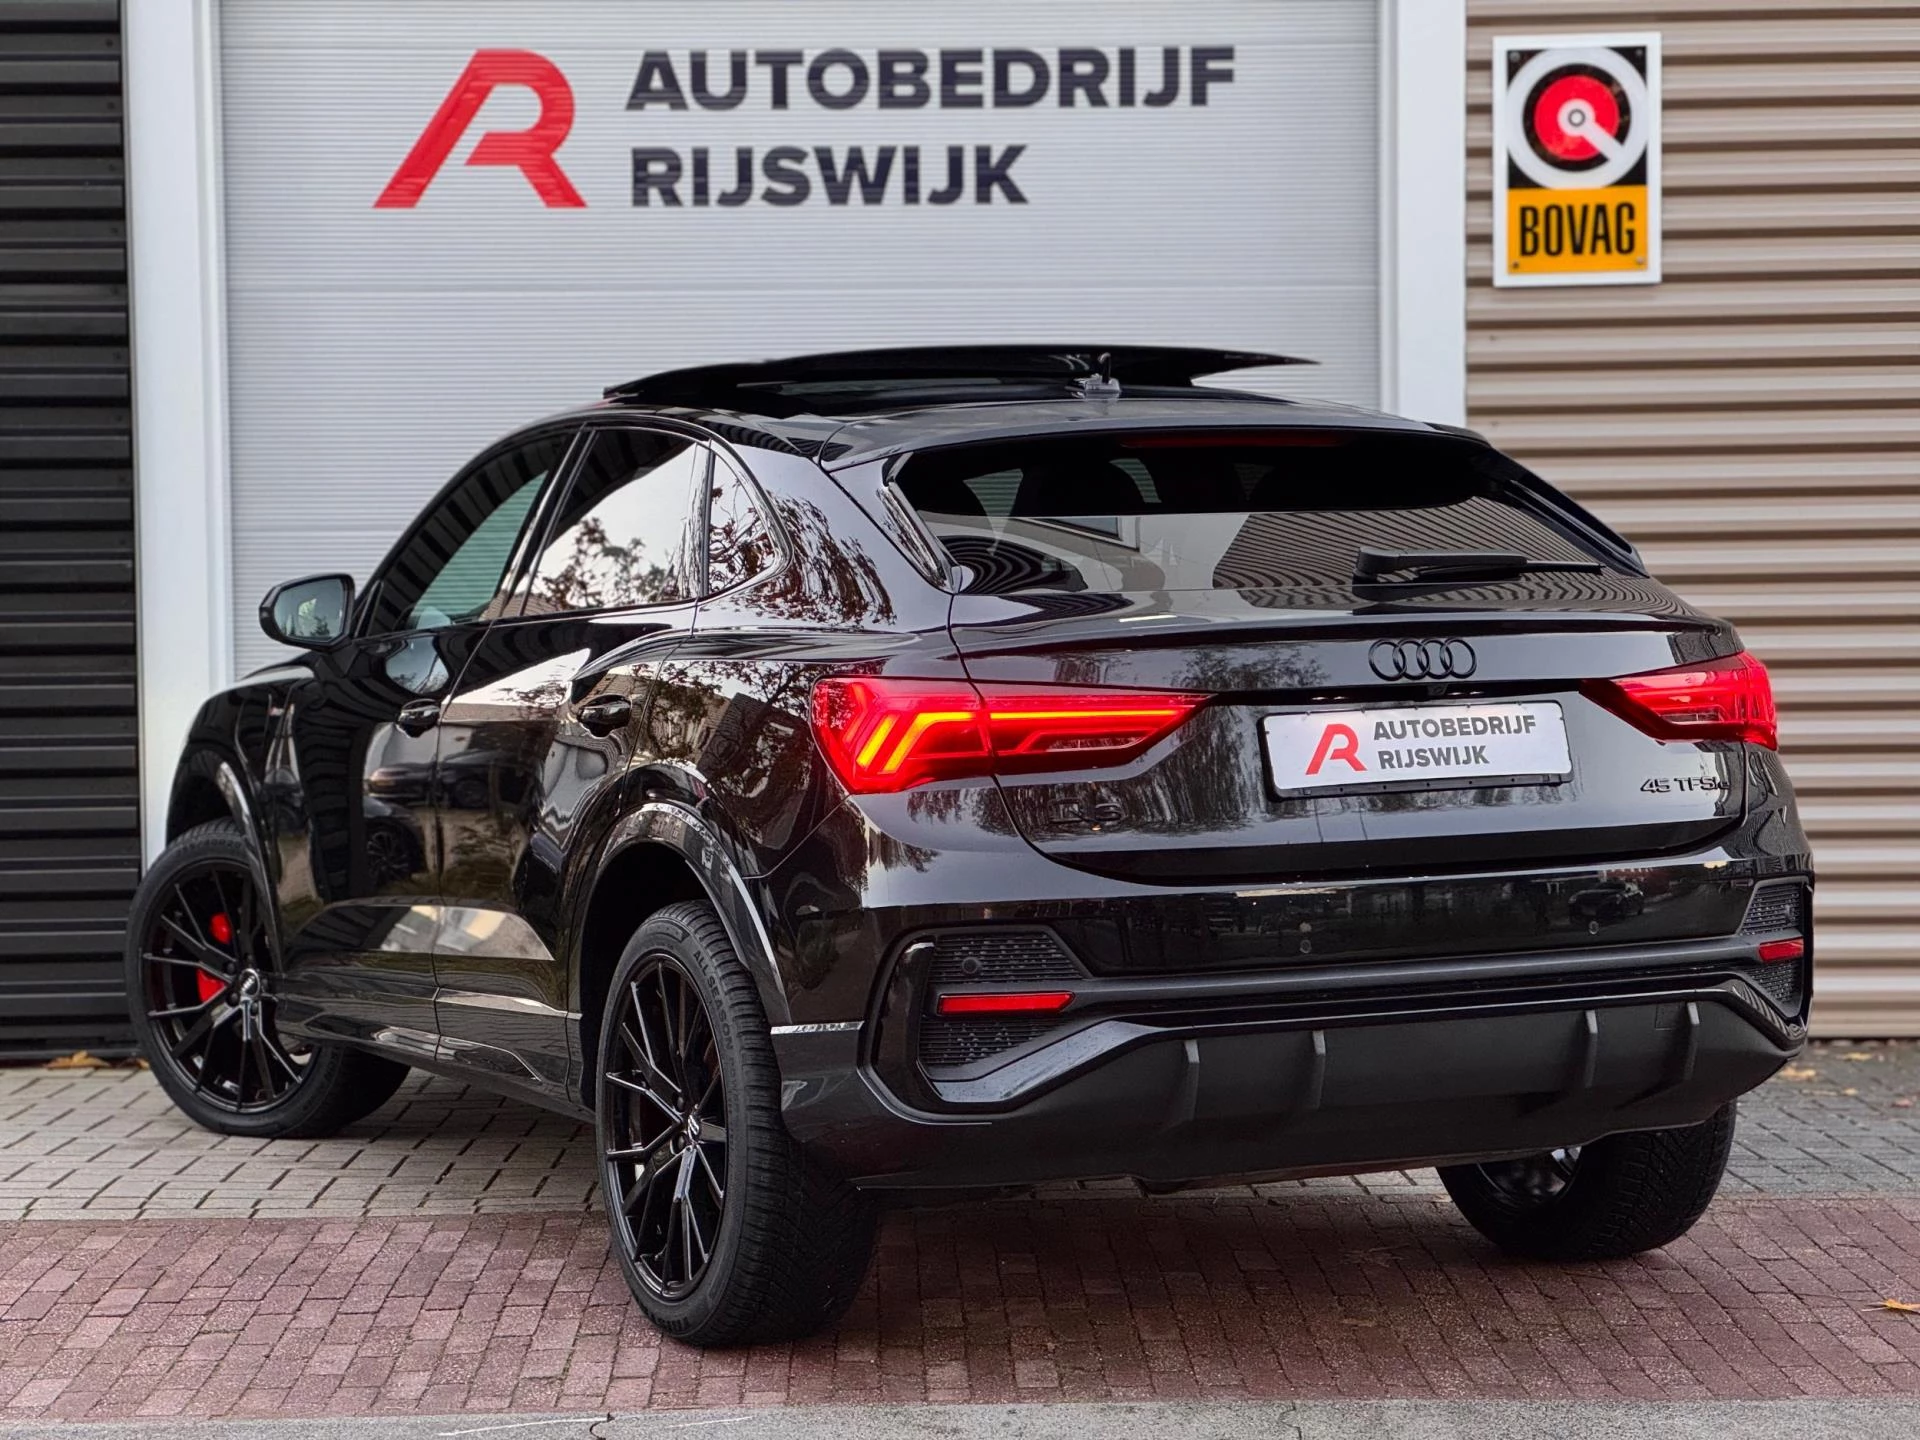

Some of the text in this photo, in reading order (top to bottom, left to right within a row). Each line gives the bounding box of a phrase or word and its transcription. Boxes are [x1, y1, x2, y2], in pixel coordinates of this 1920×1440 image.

[625, 46, 1235, 111] AUTOBEDRIJF
[631, 144, 1029, 208] RIJSWIJK
[1519, 202, 1636, 257] BOVAG
[1373, 714, 1536, 741] AUTOBEDRIJF
[1378, 745, 1489, 770] RIJSWIJK
[1640, 778, 1671, 793] 45
